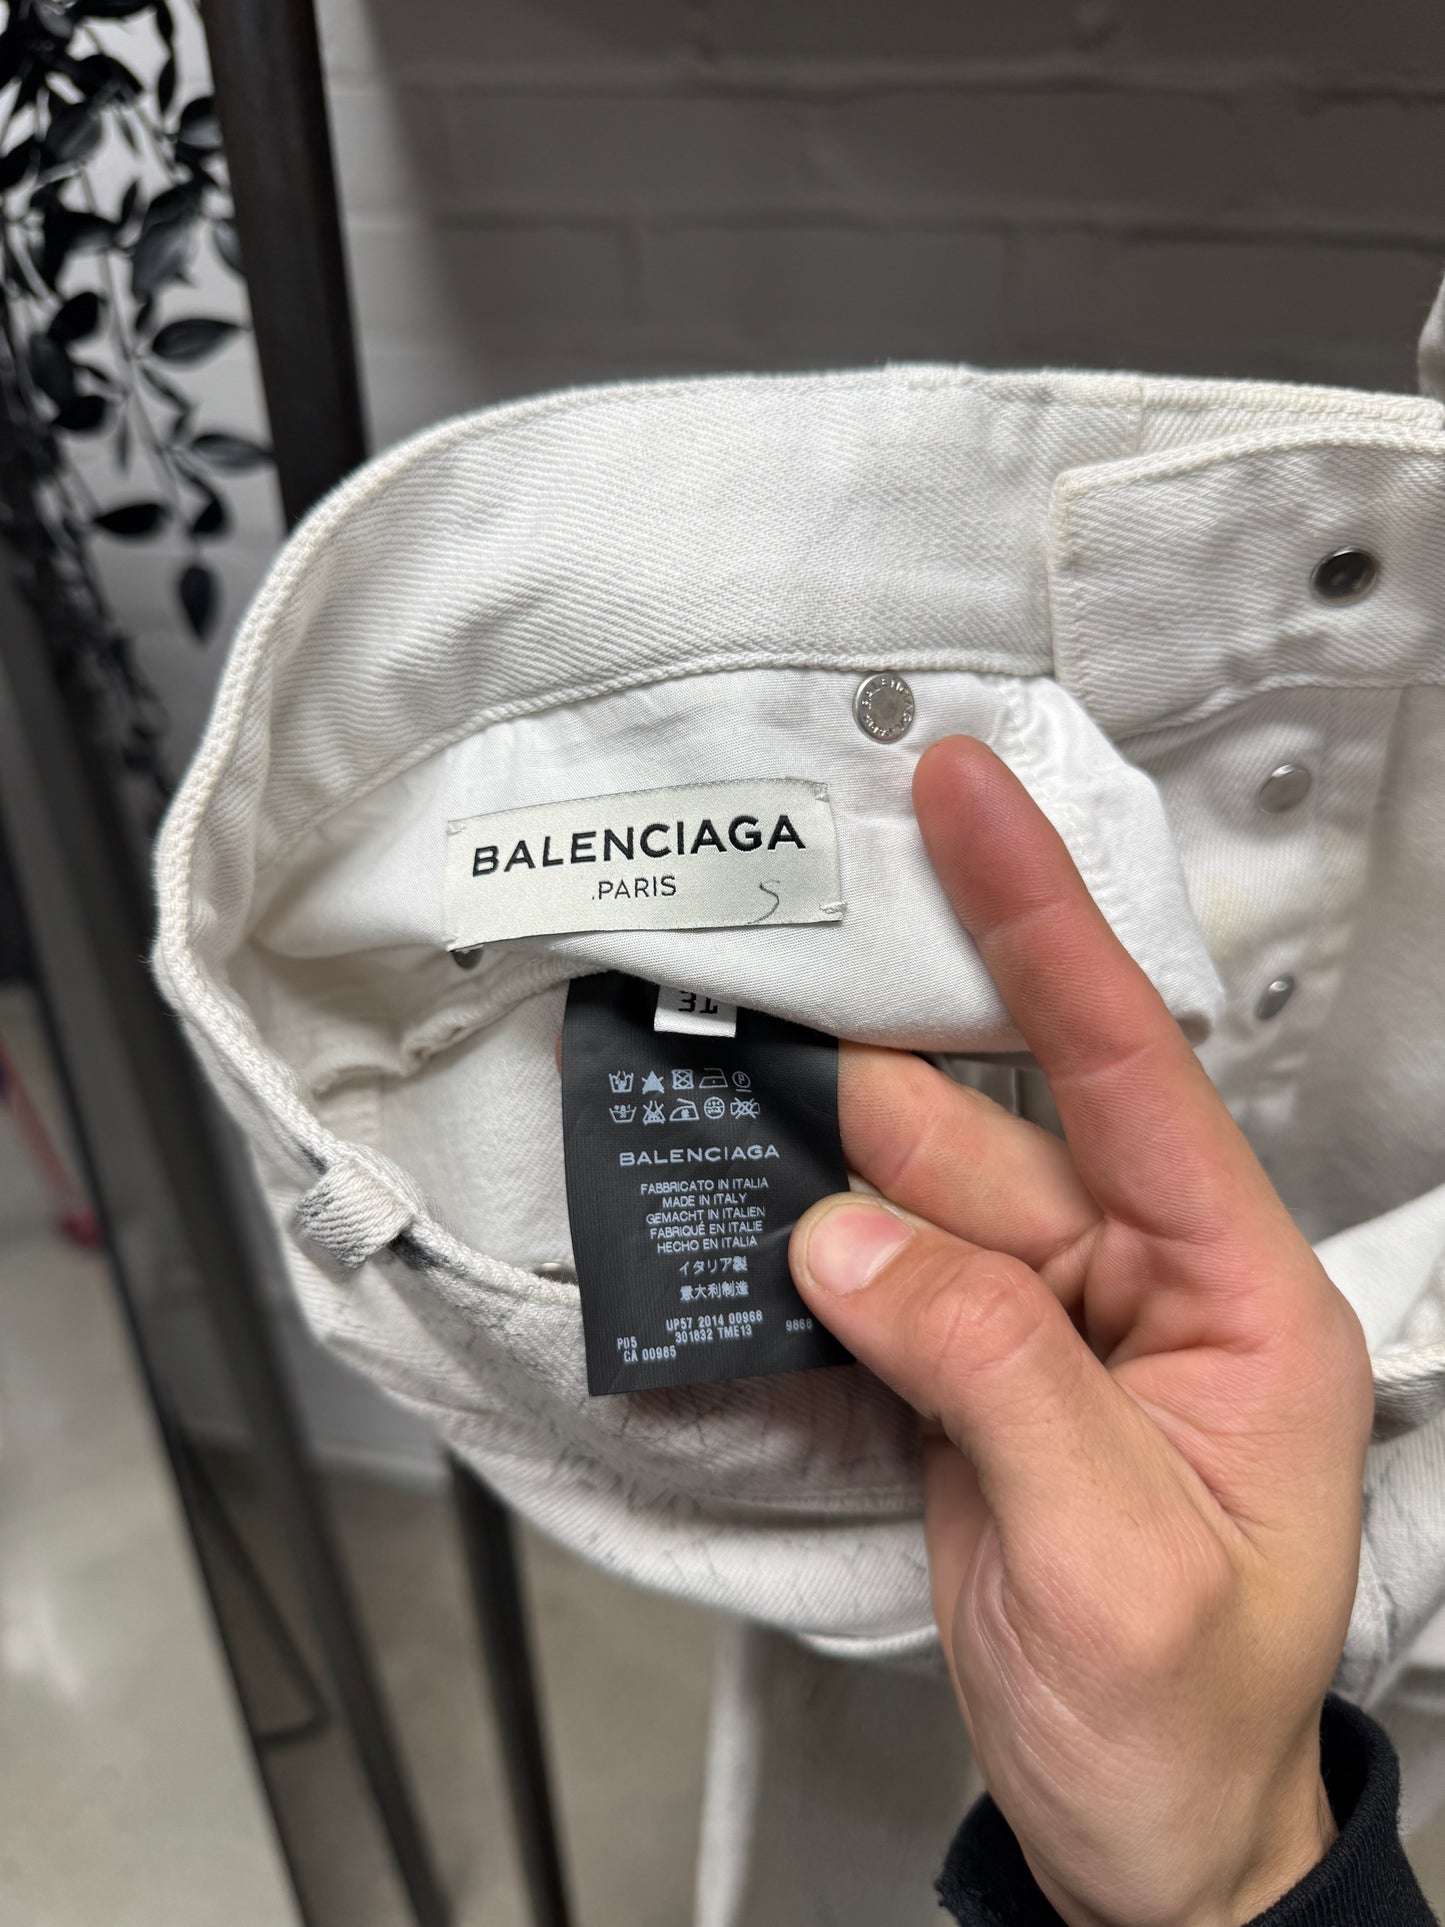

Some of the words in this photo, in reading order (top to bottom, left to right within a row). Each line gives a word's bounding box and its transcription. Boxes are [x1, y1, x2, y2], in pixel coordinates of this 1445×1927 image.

[472, 814, 806, 878] BALENCIAGA
[619, 1144, 780, 1167] BALENCIAGA
[640, 1179, 714, 1195] FABBRICATO
[718, 1179, 729, 1189] IN
[732, 1177, 769, 1189] ITALIA
[662, 1195, 695, 1208] MADE
[699, 1194, 710, 1206] IN
[713, 1192, 747, 1205] ITALY
[646, 1209, 704, 1225] GEMACHT
[708, 1209, 719, 1220] IN
[722, 1206, 765, 1219] ITALIEN
[650, 1221, 706, 1240] FABRIQUÉ
[709, 1221, 725, 1234] EN
[728, 1220, 763, 1233] ITALIE
[657, 1239, 699, 1253] HECHO
[703, 1238, 718, 1250] EN
[722, 1234, 758, 1248] ITALIA
[679, 1255, 748, 1276] イタリア製
[666, 1317, 693, 1332] UP57
[698, 1313, 724, 1328] 2014
[675, 1329, 713, 1344] 301832
[717, 1325, 753, 1340] TME13
[623, 1350, 639, 1363] CA
